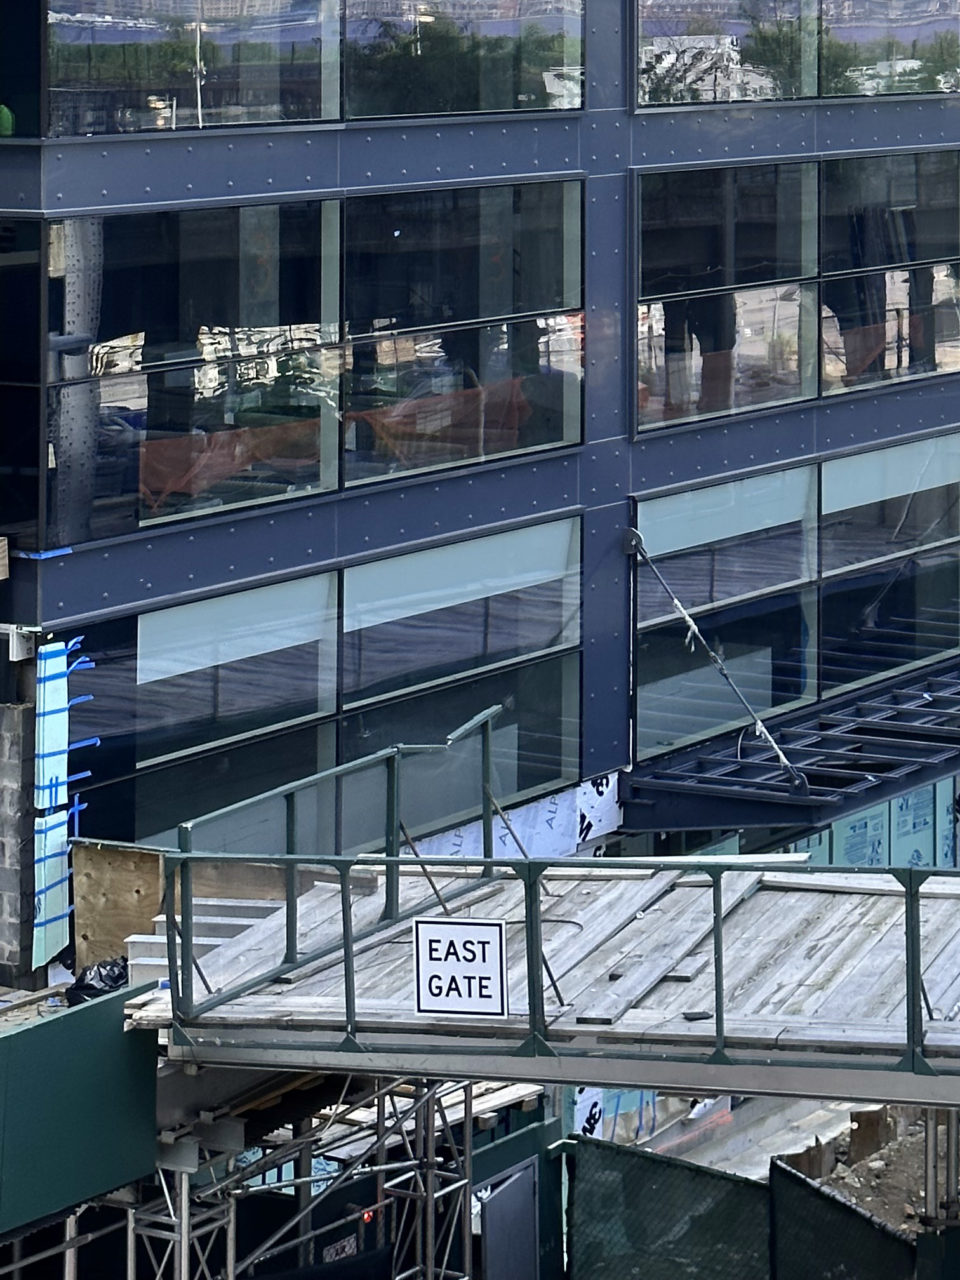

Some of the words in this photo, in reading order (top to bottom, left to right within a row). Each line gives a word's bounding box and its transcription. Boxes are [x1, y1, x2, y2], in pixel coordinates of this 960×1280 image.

[428, 939, 490, 963] EAST
[428, 974, 492, 999] GATE
[581, 1101, 602, 1136] 3M
